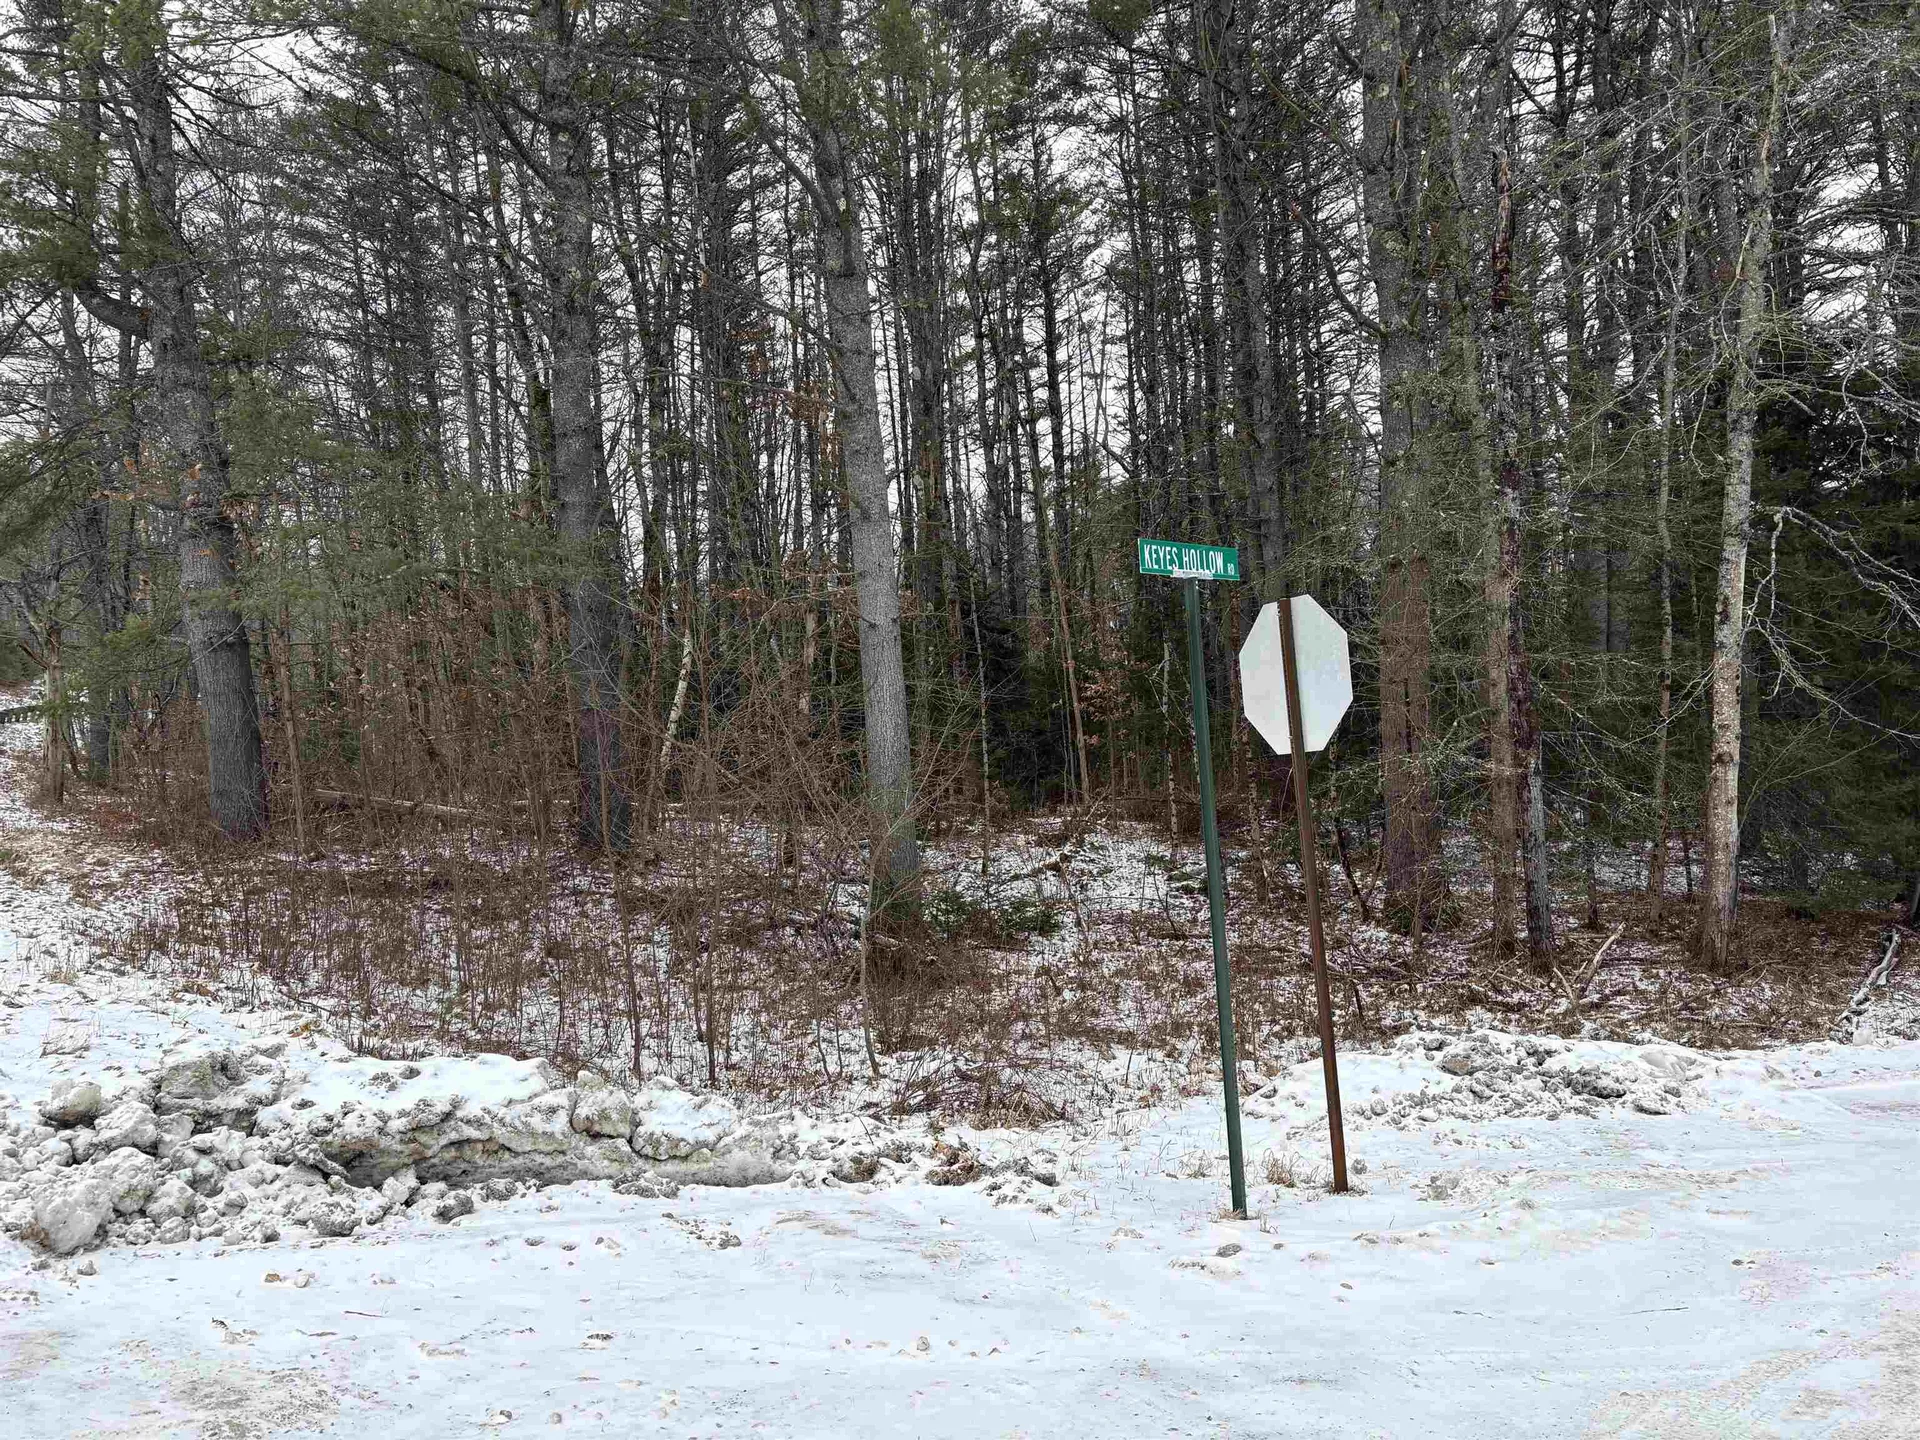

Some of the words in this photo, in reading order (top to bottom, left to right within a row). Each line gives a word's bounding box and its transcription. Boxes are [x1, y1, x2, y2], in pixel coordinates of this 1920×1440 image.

[1144, 544, 1178, 570] KEYES
[1182, 548, 1224, 574] HOLLOW
[1227, 563, 1235, 575] RD
